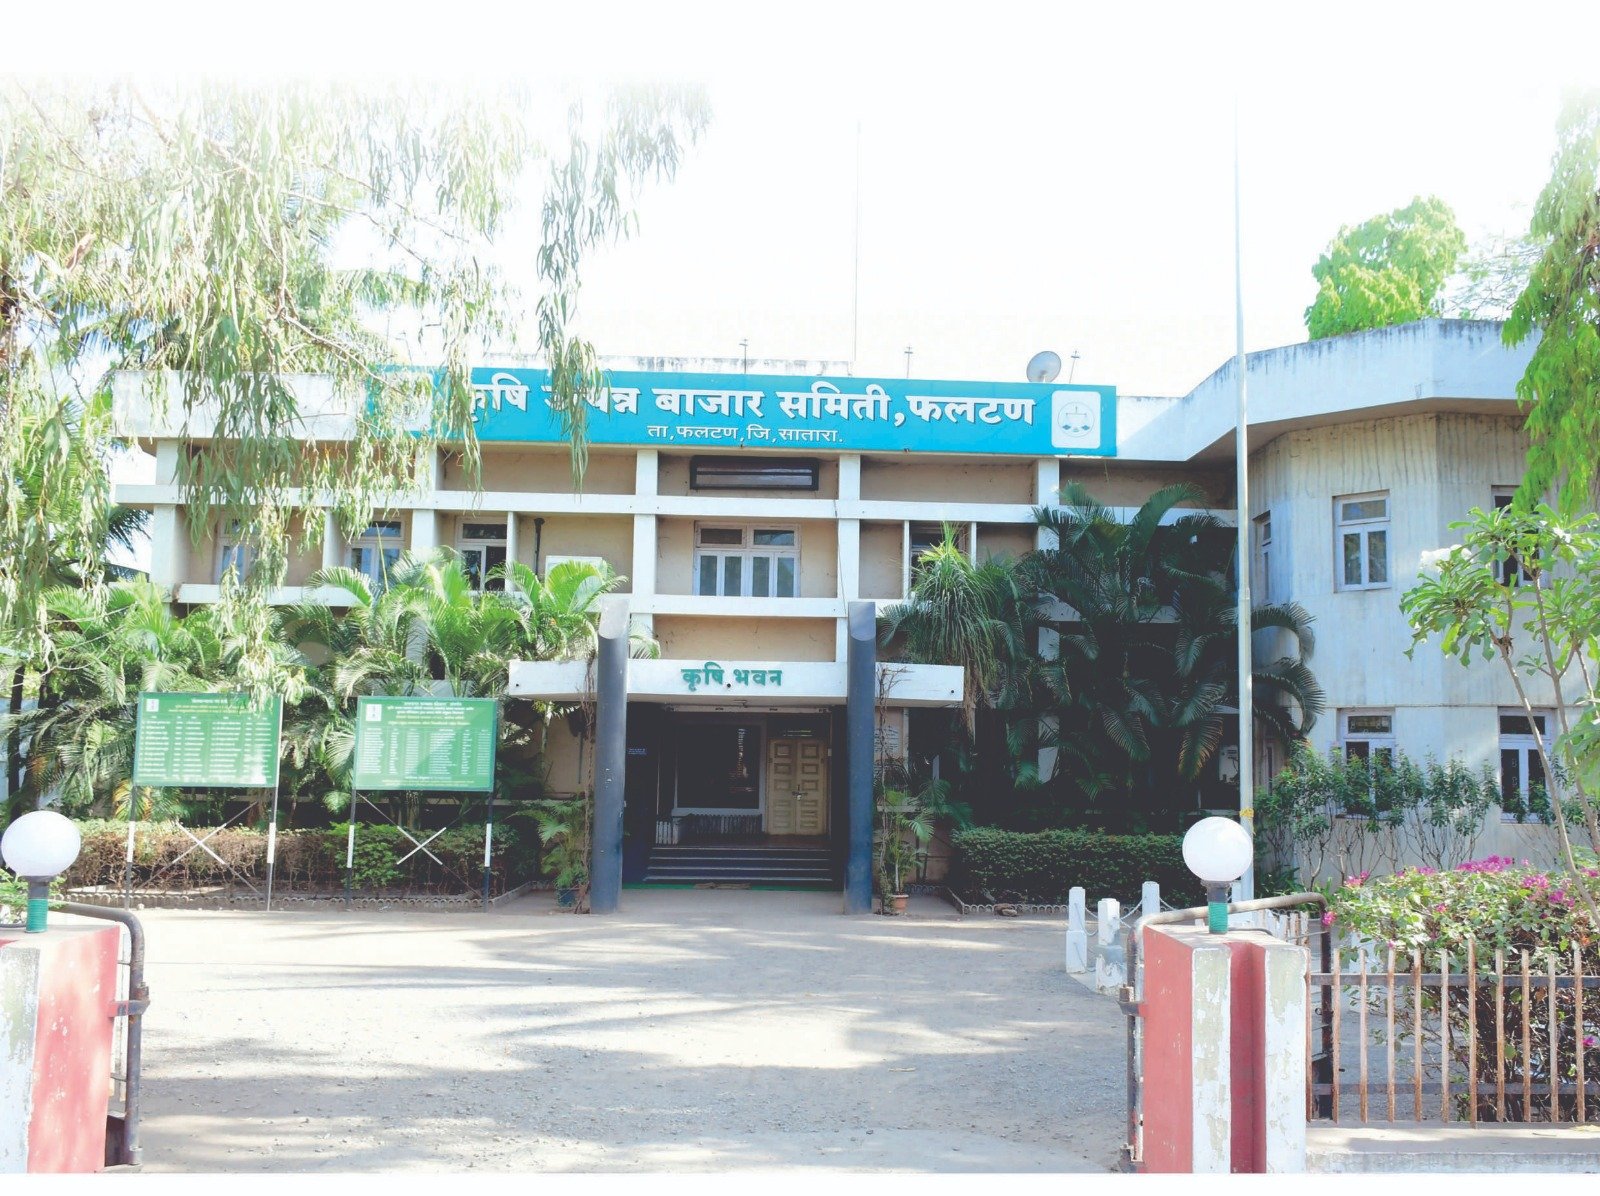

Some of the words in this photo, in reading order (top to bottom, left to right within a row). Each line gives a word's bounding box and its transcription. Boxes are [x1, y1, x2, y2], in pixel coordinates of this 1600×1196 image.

[652, 388, 765, 418] बाजार
[680, 661, 725, 692] कृषि
[733, 668, 782, 686] भवन
